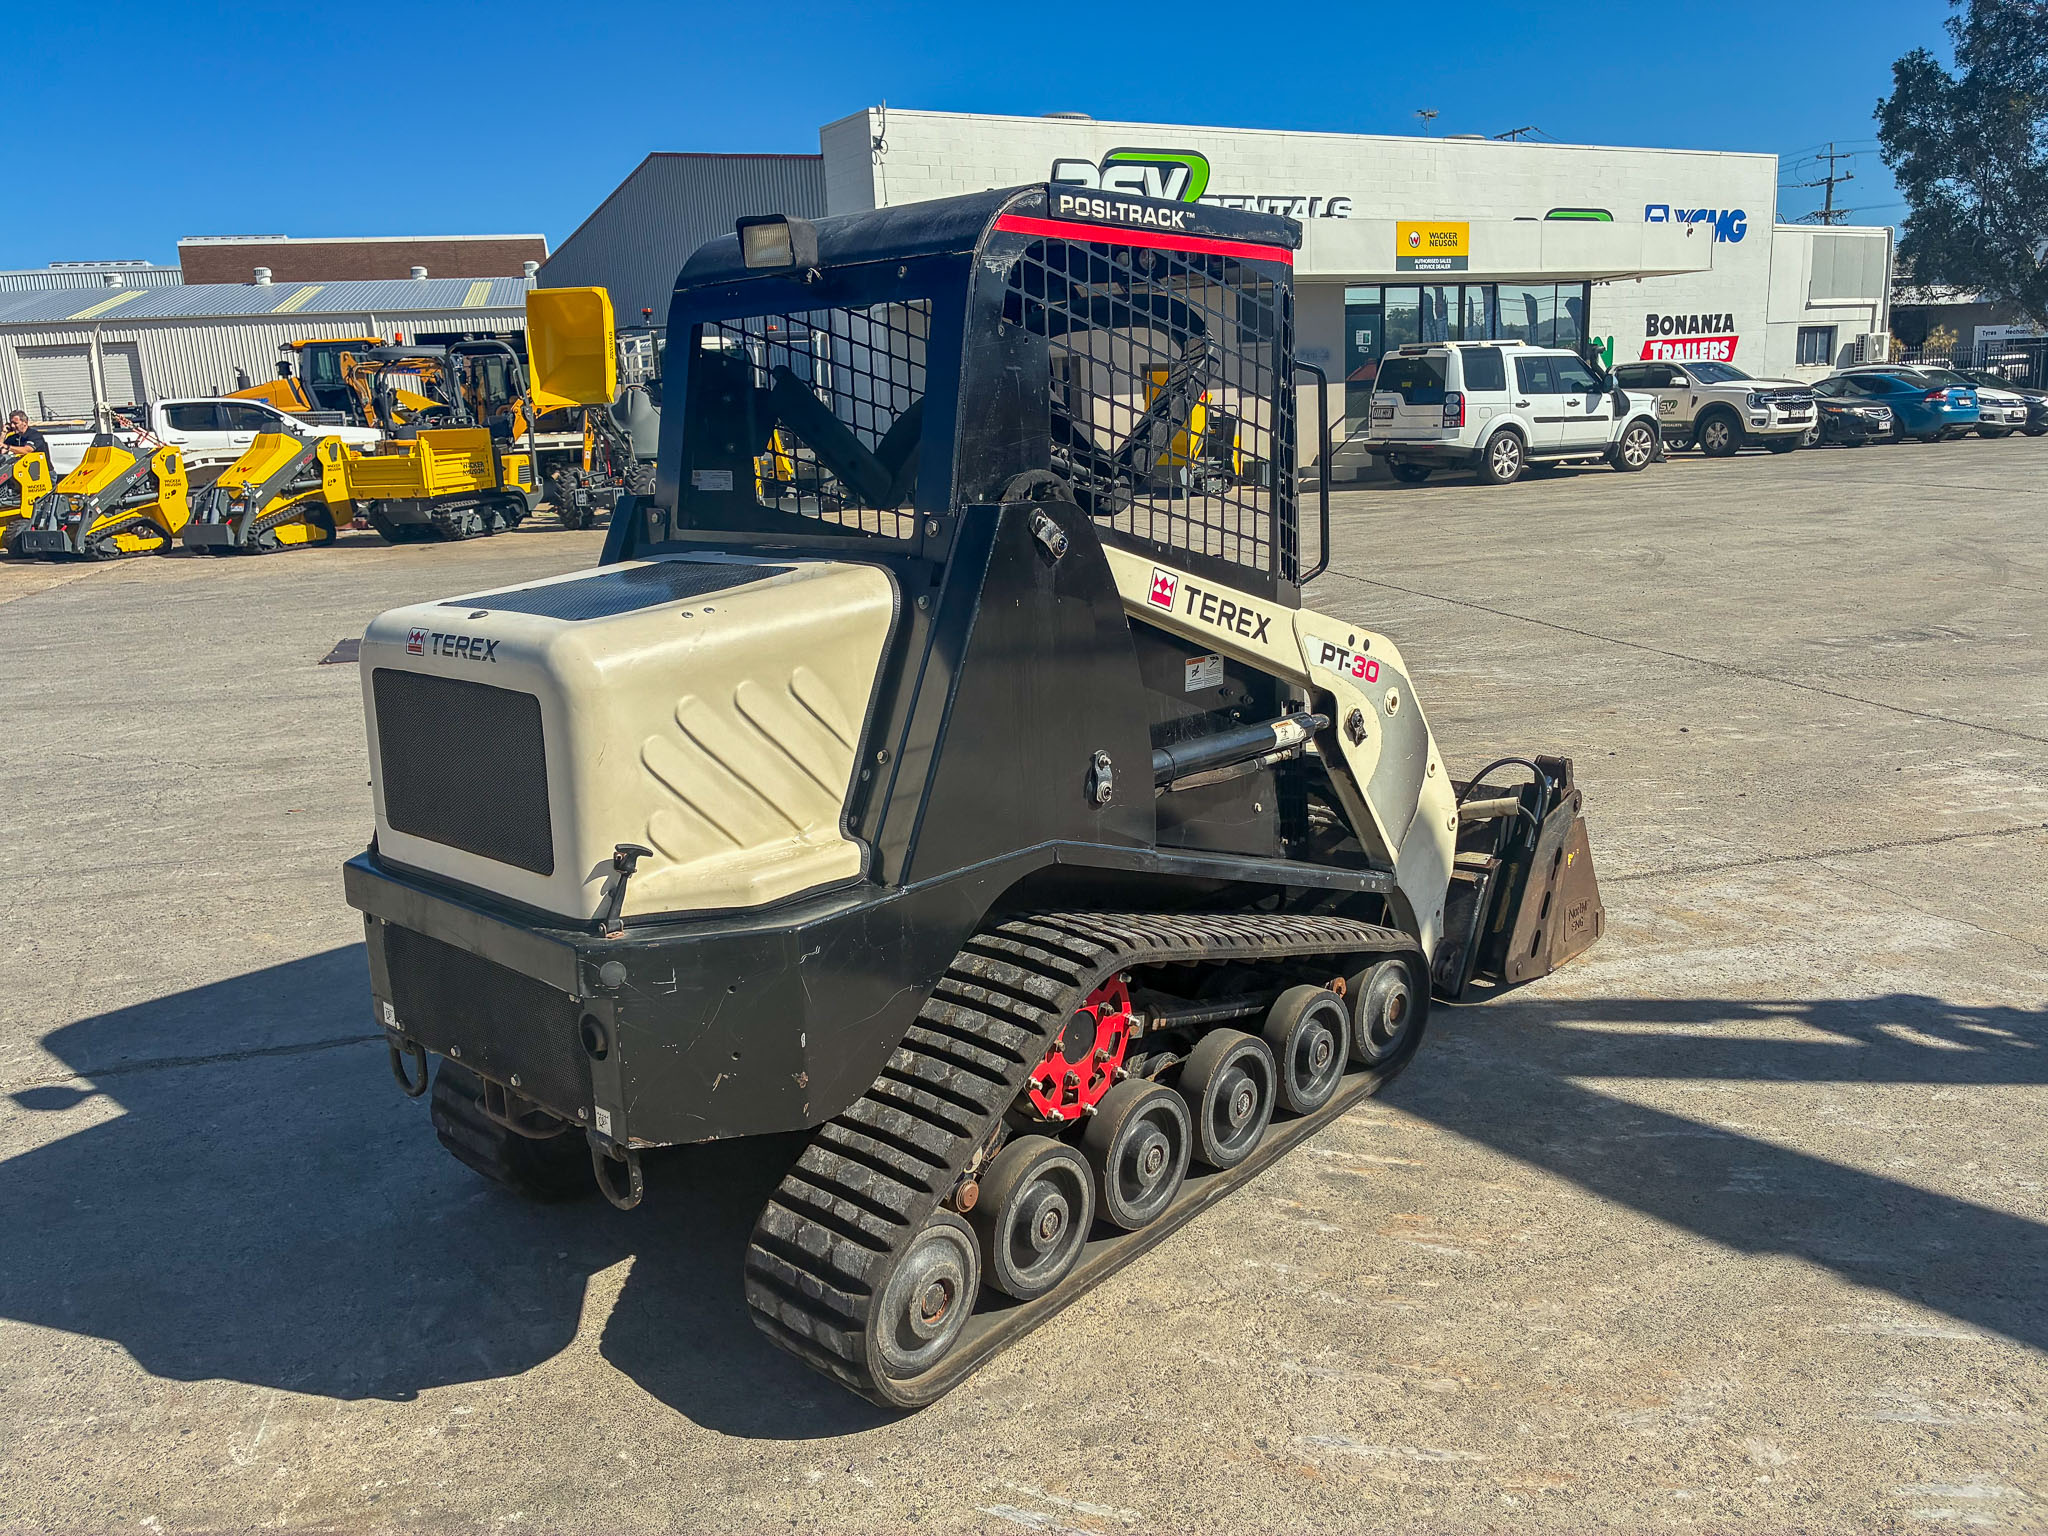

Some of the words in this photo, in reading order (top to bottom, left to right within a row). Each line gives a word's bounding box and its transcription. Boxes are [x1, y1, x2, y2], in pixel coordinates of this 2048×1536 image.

[1429, 231, 1457, 240] WACKER
[1429, 239, 1457, 247] NEUSON
[1646, 313, 1735, 338] BONANZA
[1650, 340, 1730, 360] TRAILERS
[1184, 584, 1272, 645] TEREX
[431, 632, 500, 663] TEREX
[1320, 642, 1380, 683] PT-30
